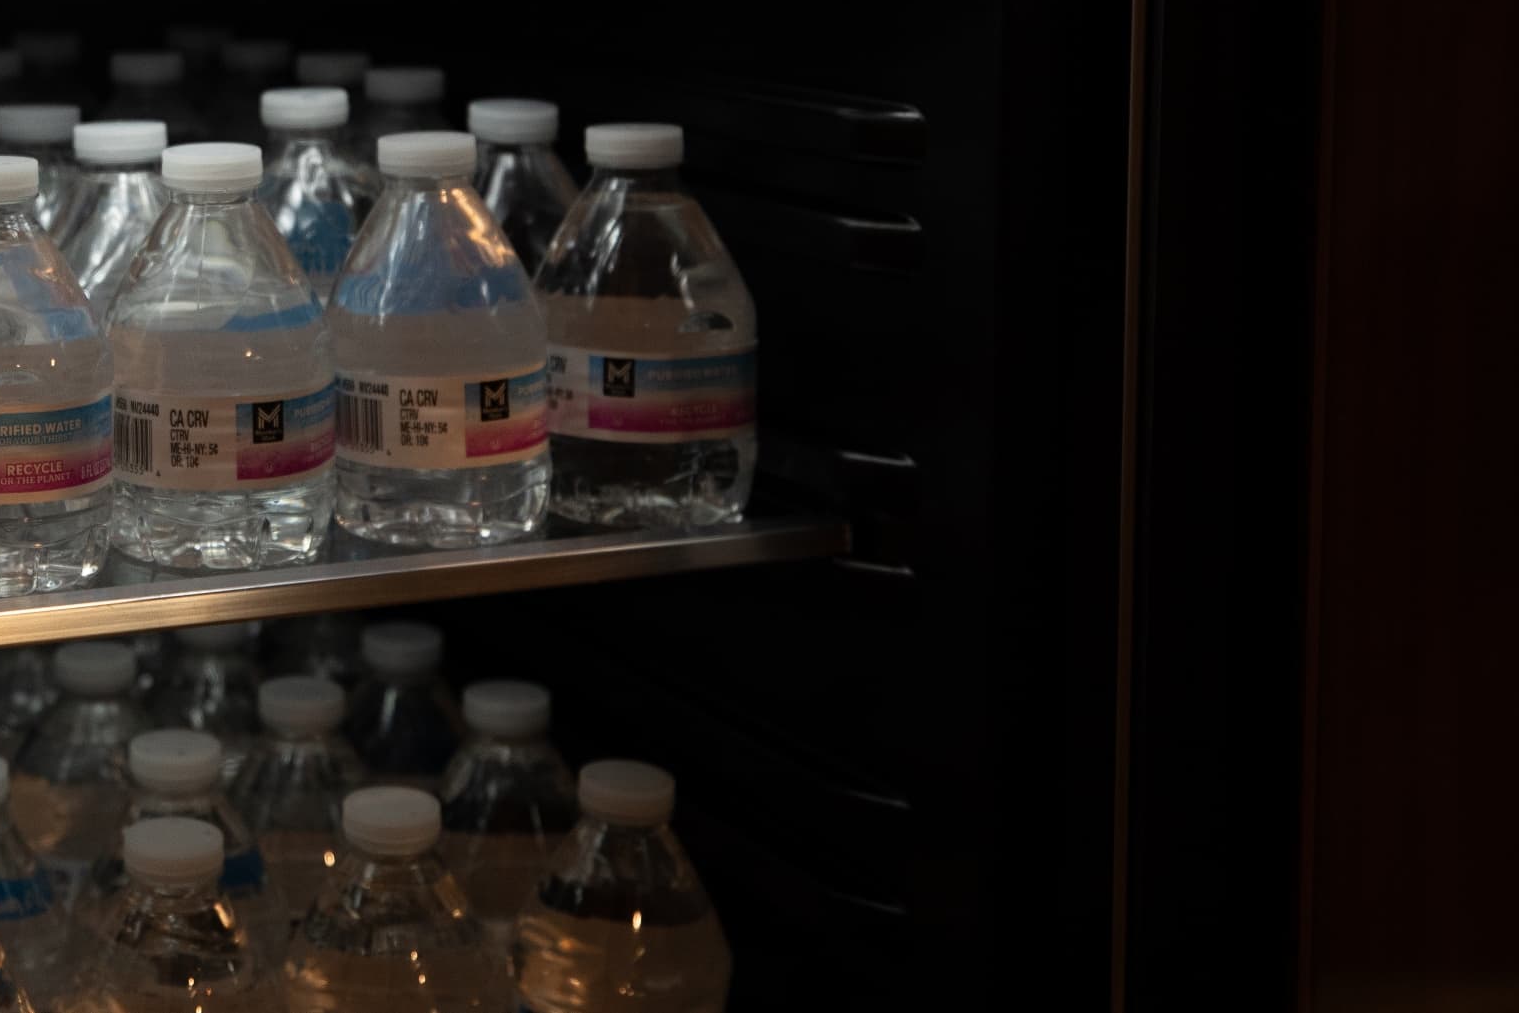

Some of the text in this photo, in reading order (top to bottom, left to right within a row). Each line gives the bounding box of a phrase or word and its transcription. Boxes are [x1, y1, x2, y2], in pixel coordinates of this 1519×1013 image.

[399, 388, 414, 407] CA
[416, 389, 439, 407] CRV
[169, 409, 209, 428] CA CRV
[400, 408, 419, 421] CTRV
[44, 419, 82, 434] WATER
[400, 421, 448, 434] ME-HI-NY: 5¢
[170, 428, 189, 441] CTRV
[401, 434, 429, 447] OR: 10¢
[170, 442, 219, 456] ME-HI-NY: 5¢
[7, 462, 63, 476] RECYCLE
[170, 455, 199, 469] OR: 10¢
[16, 476, 35, 485] THE
[36, 472, 71, 484] PLANET
